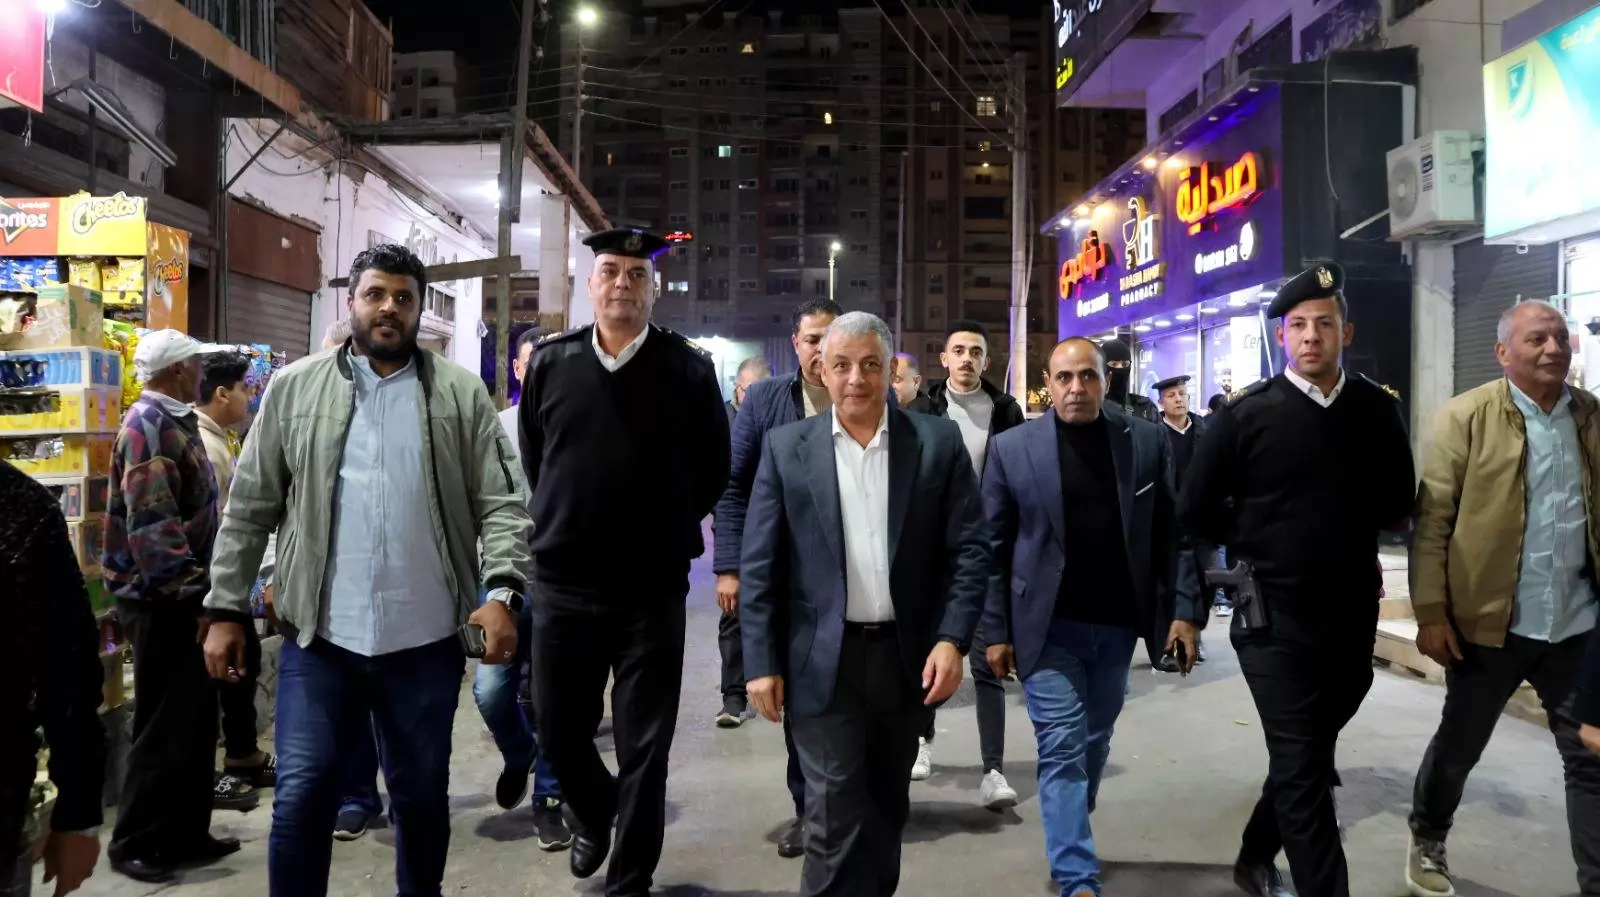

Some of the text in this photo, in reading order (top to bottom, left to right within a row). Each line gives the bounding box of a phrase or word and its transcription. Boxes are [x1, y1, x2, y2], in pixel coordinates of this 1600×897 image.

[72, 192, 140, 234] Cheetos
[1176, 151, 1258, 236] صيدلية
[0, 212, 48, 229] oritos
[153, 258, 184, 296] Cheetos
